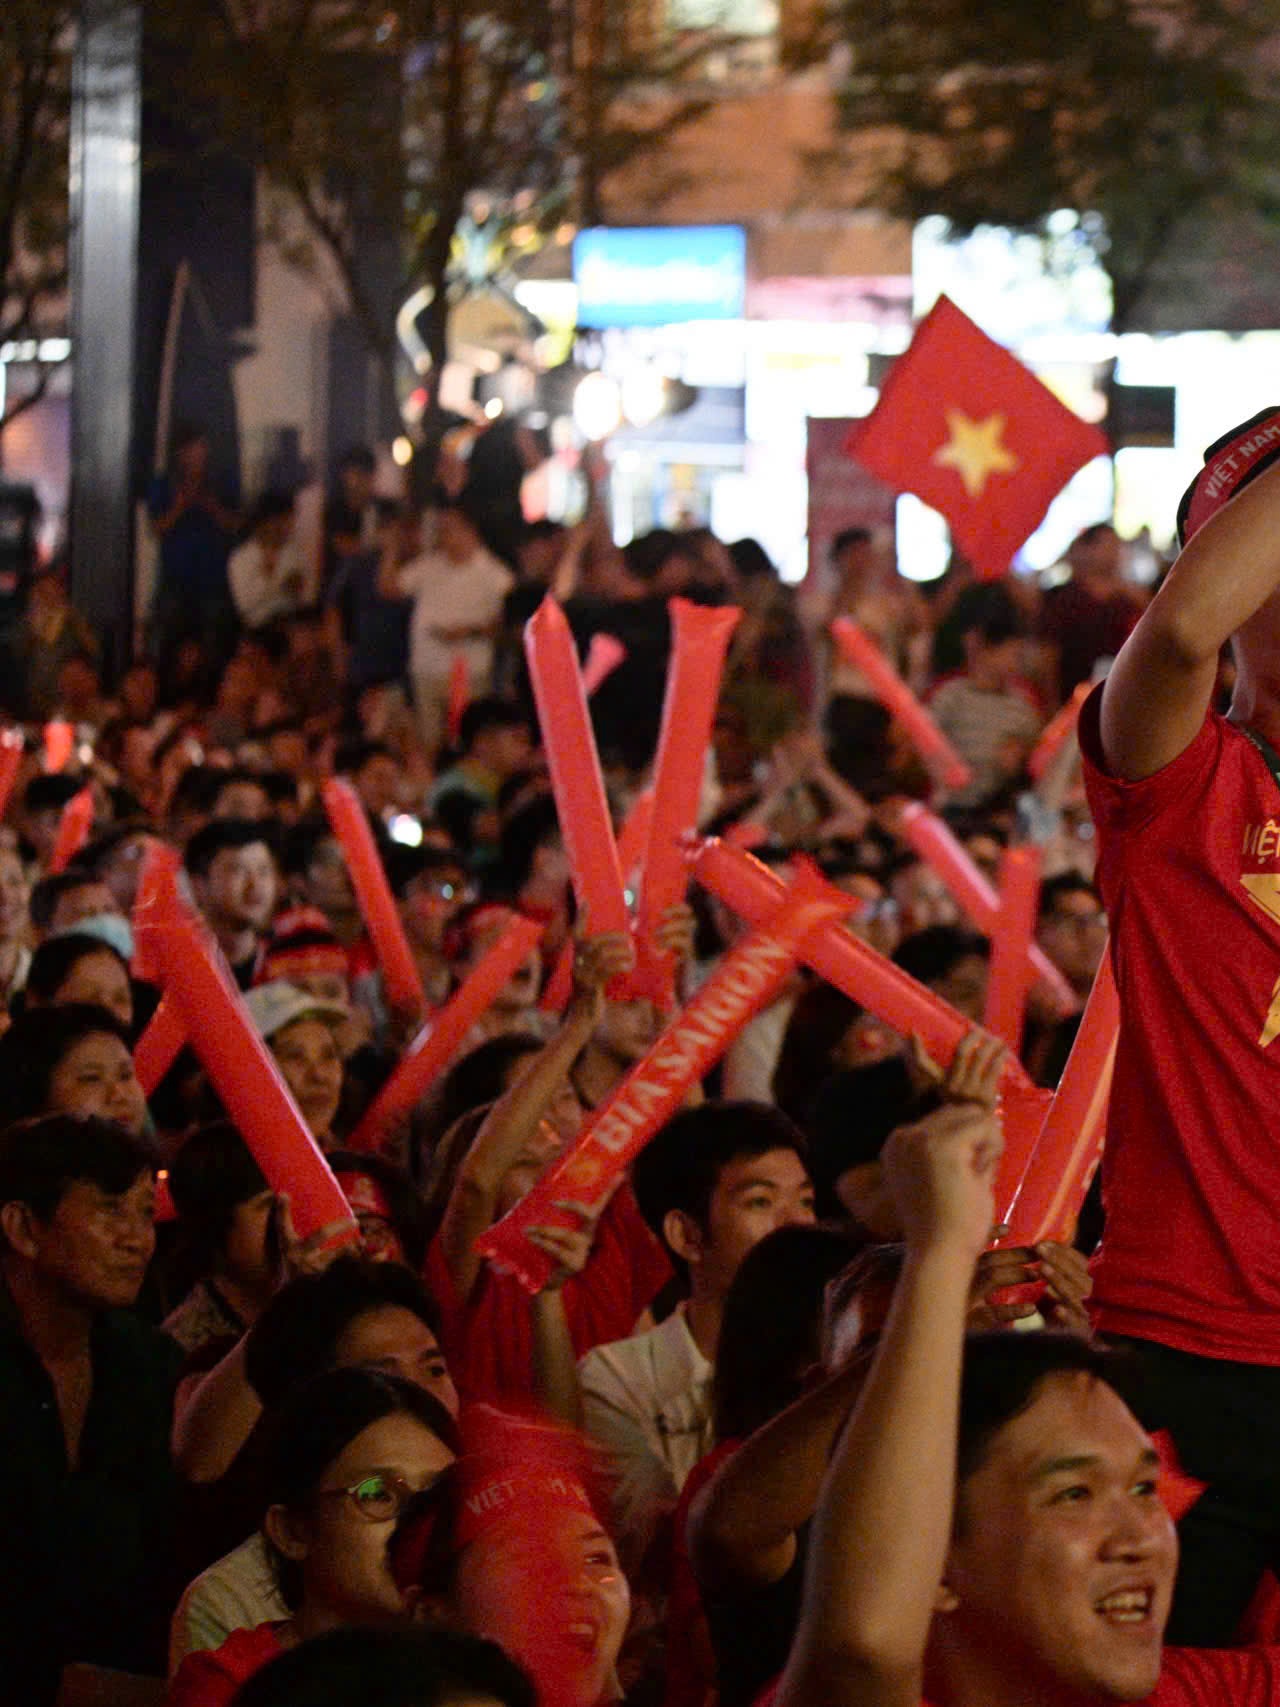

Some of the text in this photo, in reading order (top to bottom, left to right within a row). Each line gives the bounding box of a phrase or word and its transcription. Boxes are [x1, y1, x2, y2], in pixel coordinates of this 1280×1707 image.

[1205, 454, 1240, 498] VIỆT
[592, 935, 790, 1151] BIA SAIGON
